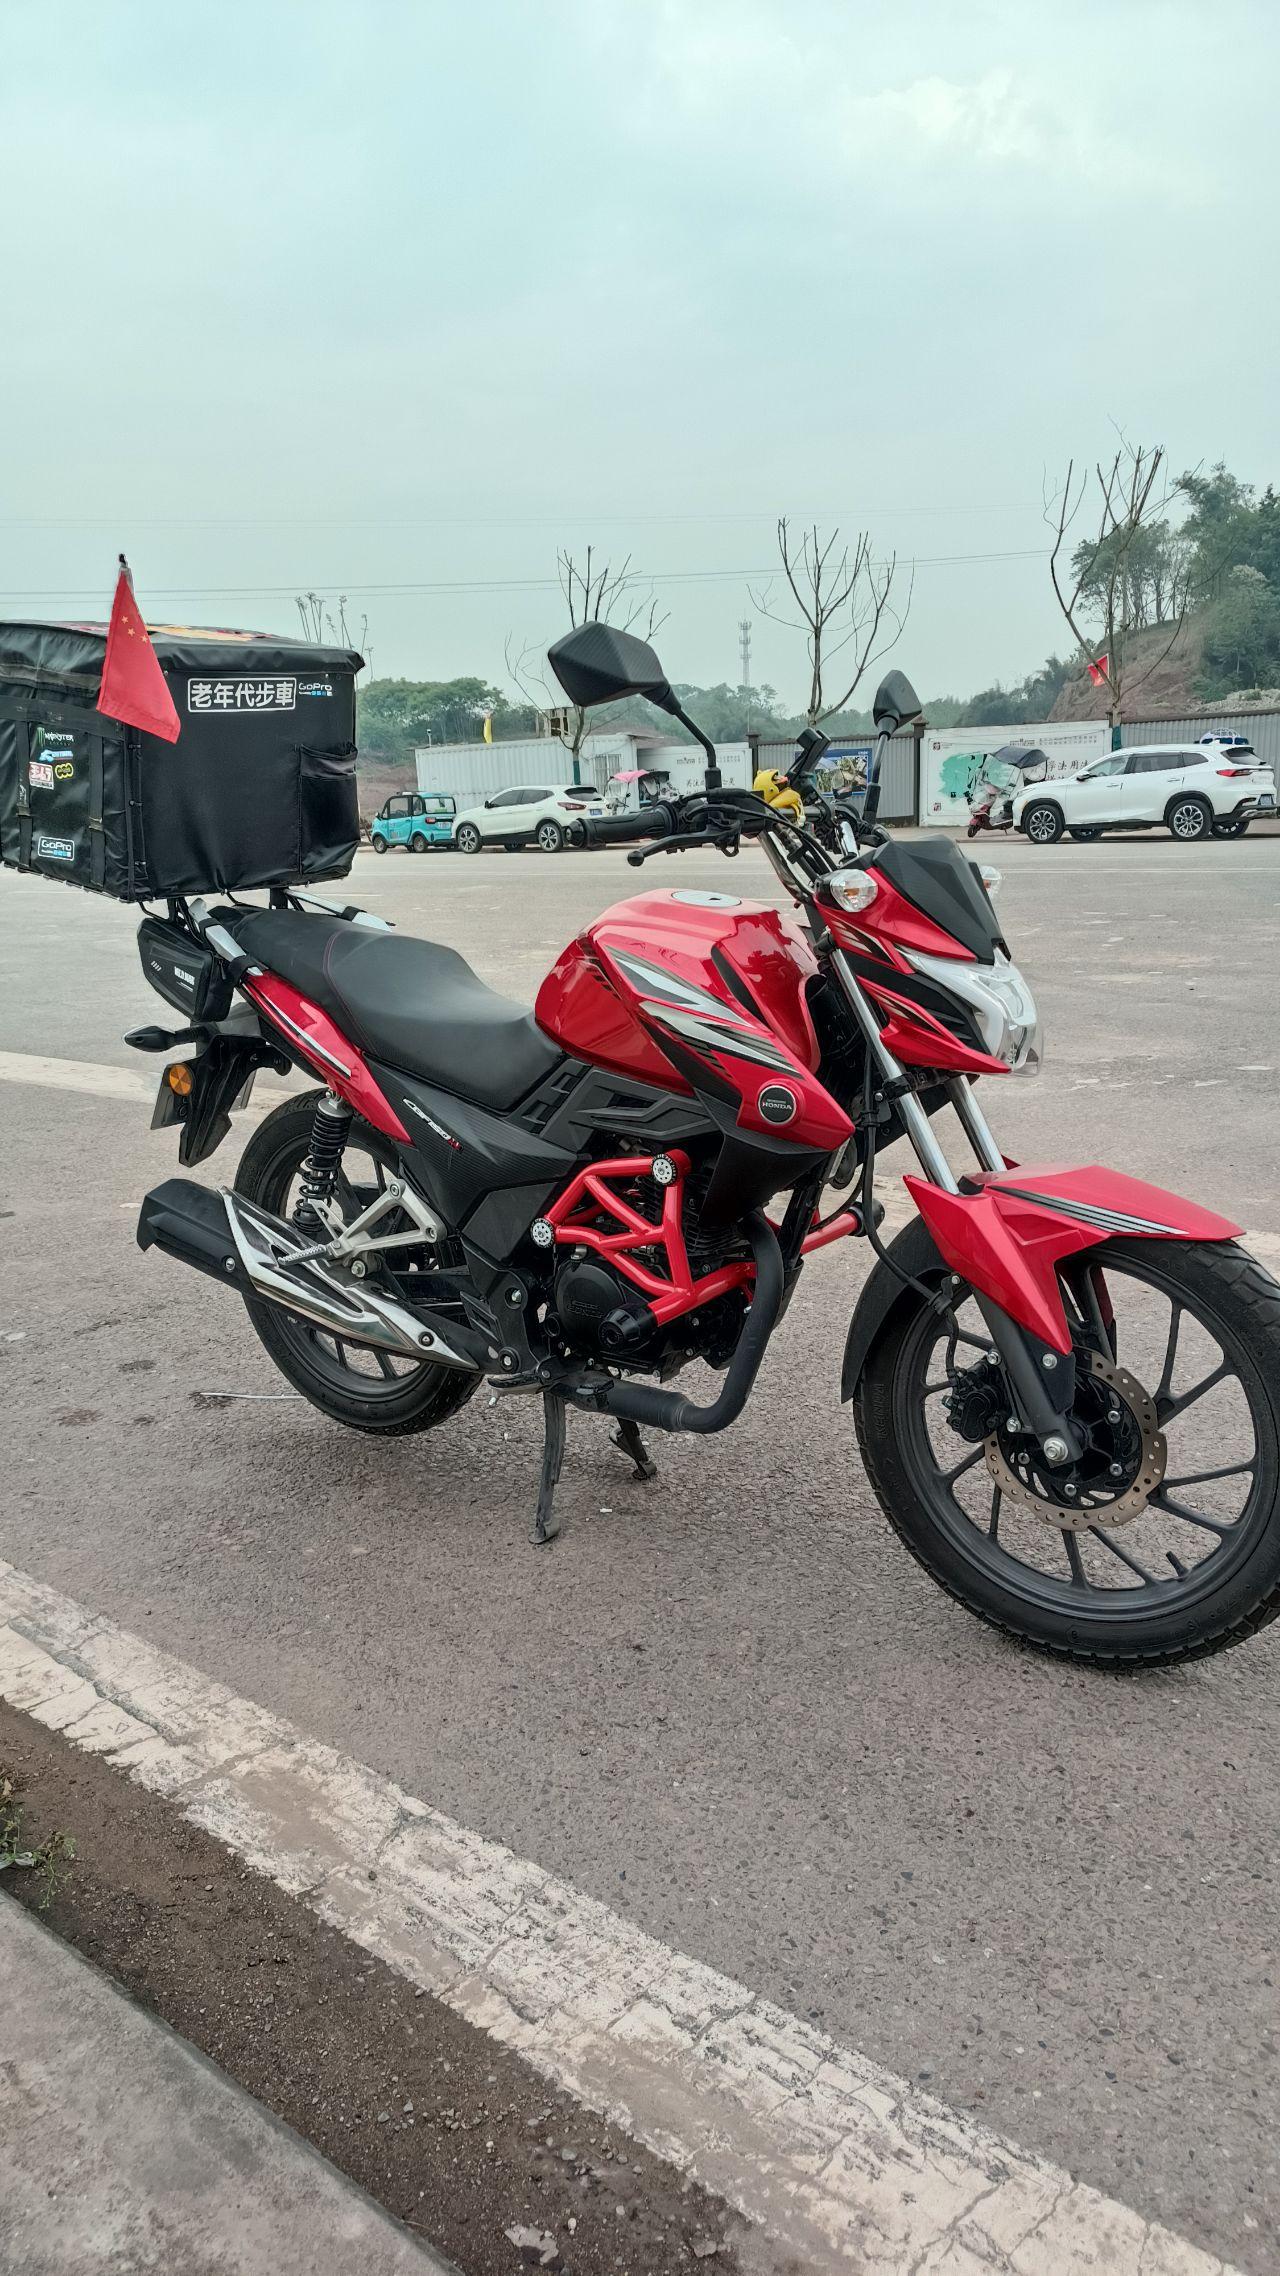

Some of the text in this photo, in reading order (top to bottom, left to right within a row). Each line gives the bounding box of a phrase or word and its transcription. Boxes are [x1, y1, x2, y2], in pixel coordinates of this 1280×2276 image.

[298, 682, 333, 691] GoPro
[191, 682, 294, 709] 老年代步車
[41, 839, 72, 851] GoPro
[762, 1101, 793, 1111] HONDA
